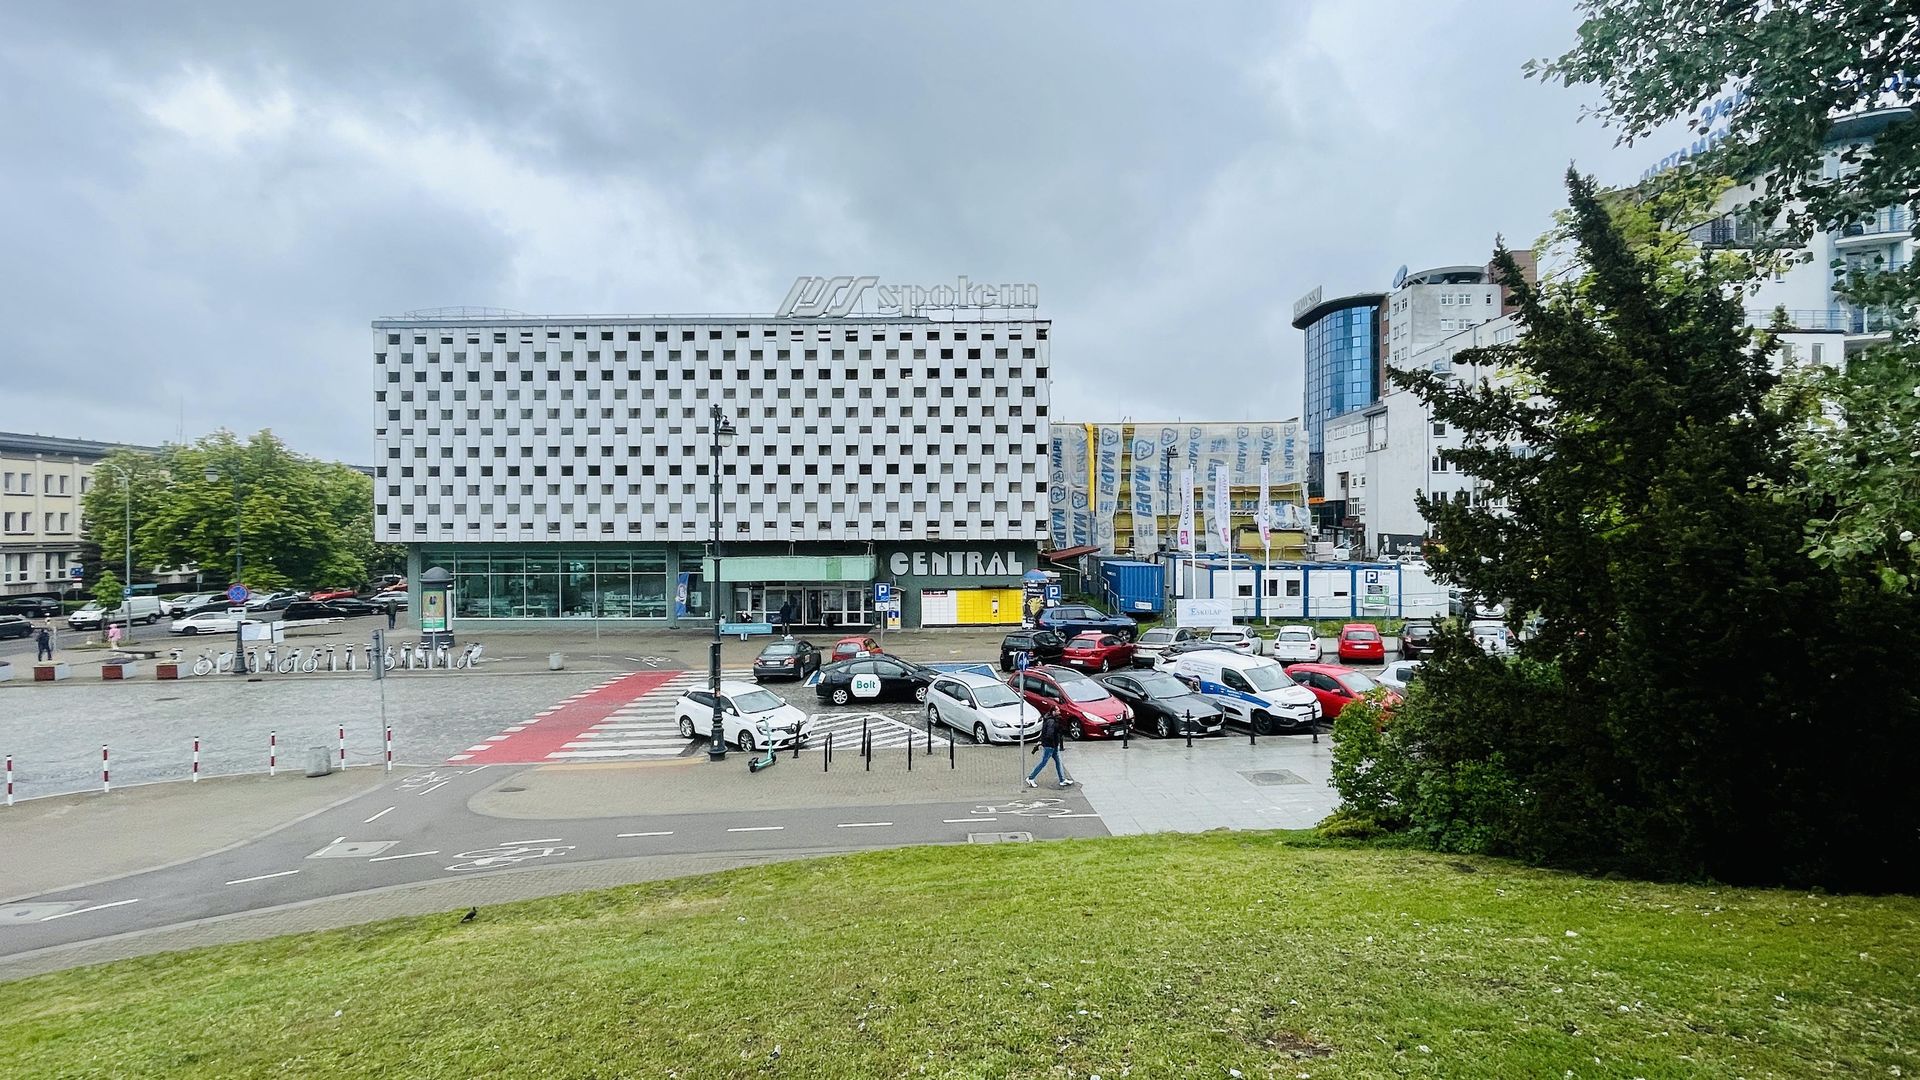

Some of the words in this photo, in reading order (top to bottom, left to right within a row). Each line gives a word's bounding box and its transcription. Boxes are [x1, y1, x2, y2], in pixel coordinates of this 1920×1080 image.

[1101, 450, 1116, 496] MAPEI
[1134, 465, 1152, 517] MAPEI
[889, 551, 1023, 576] CENTRAL
